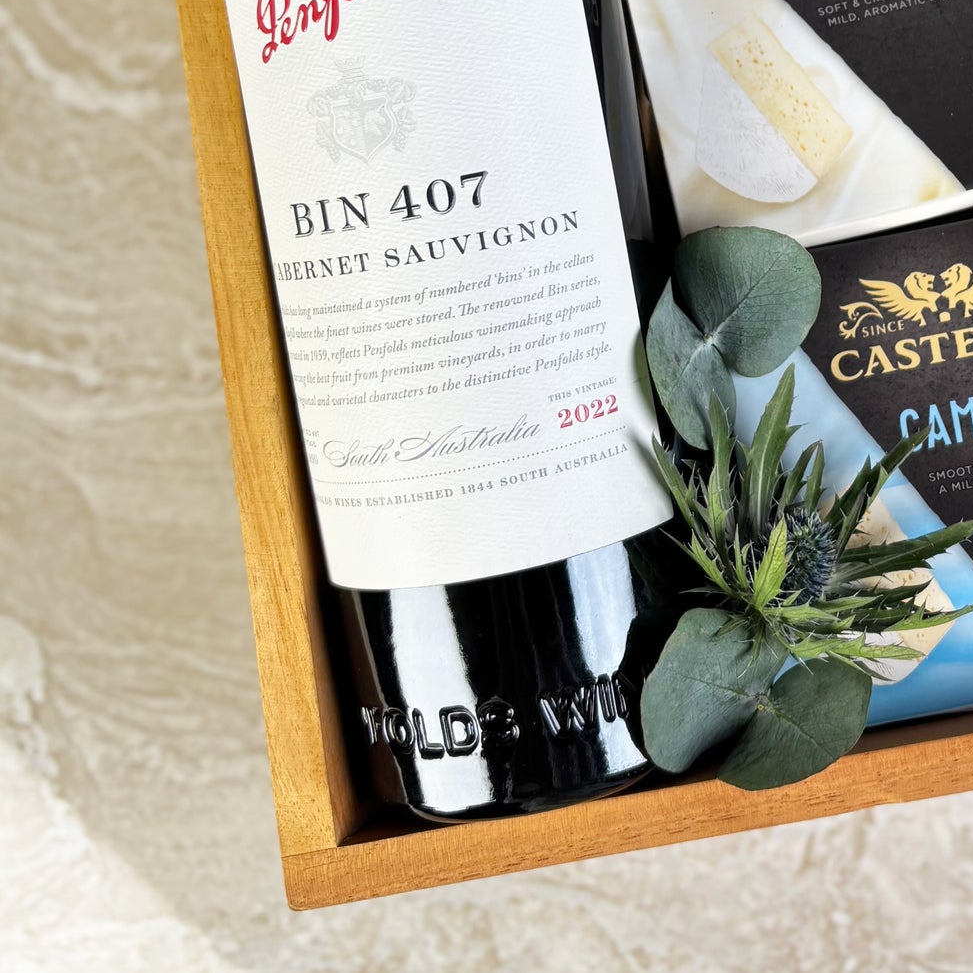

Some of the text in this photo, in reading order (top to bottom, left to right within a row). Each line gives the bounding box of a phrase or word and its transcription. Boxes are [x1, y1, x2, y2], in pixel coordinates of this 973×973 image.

[817, 1, 849, 16] SOFT
[827, 12, 861, 27] MILD,
[290, 170, 489, 239] BIN 407
[276, 210, 580, 281] ABERNET SAUVIGNON
[313, 298, 363, 315] maintained
[365, 301, 372, 309] a
[375, 294, 411, 311] system
[414, 287, 428, 305] of
[428, 275, 492, 298] numbered
[528, 267, 540, 277] in
[543, 261, 561, 274] the
[563, 253, 595, 269] cellars
[325, 325, 349, 341] finest
[351, 322, 382, 334] wines
[384, 317, 413, 330] were
[416, 307, 456, 325] stored.
[457, 302, 480, 317] The
[483, 287, 544, 311] renowned
[547, 284, 568, 297] Bin
[570, 275, 601, 291] series,
[310, 349, 330, 362] 1959,
[331, 346, 361, 363] reflects
[363, 339, 408, 358] Penfolds
[410, 330, 474, 349] meticulous
[476, 312, 553, 337] winemaking
[555, 296, 602, 322] approach
[331, 371, 352, 387] fruit
[353, 369, 378, 386] from
[380, 361, 435, 383] premium
[437, 345, 505, 368] vineyards,
[508, 342, 521, 353] in
[525, 334, 557, 350] order
[560, 330, 570, 341] to
[573, 320, 607, 338] marry
[862, 319, 905, 338] SINCE
[332, 391, 367, 406] varietal
[369, 386, 424, 403] characters
[427, 384, 438, 394] to
[442, 378, 461, 392] the
[464, 363, 532, 388] distinctive
[535, 348, 584, 372] Penfolds
[586, 341, 612, 361] style.
[548, 390, 573, 402] THIS
[323, 413, 542, 467] South Australia
[557, 394, 619, 429] 2022
[334, 497, 362, 507] WINES
[365, 488, 454, 507] ESTABLISHED
[460, 480, 494, 496] 1844
[499, 467, 549, 487] SOUTH
[555, 443, 629, 474] AUSTRALIA
[938, 484, 948, 495] A
